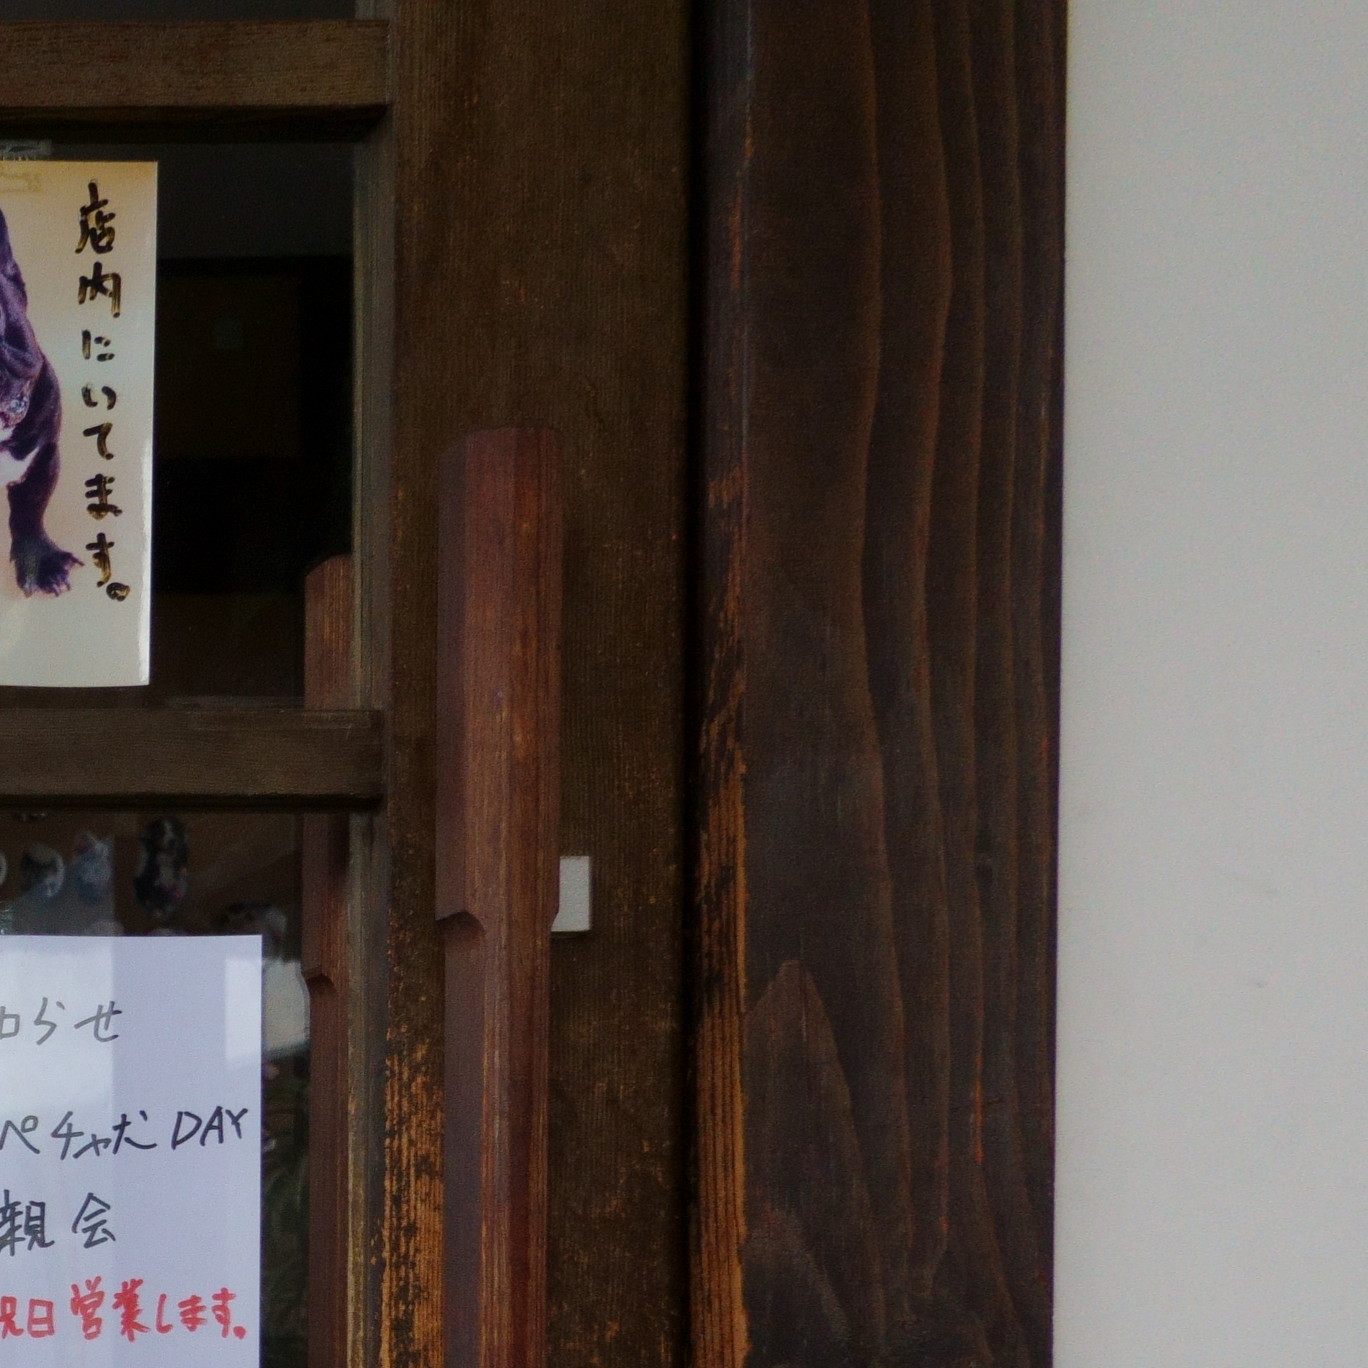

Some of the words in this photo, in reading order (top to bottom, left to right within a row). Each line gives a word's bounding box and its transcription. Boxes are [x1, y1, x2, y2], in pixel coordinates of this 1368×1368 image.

[74, 179, 131, 603] 店内にいてます。
